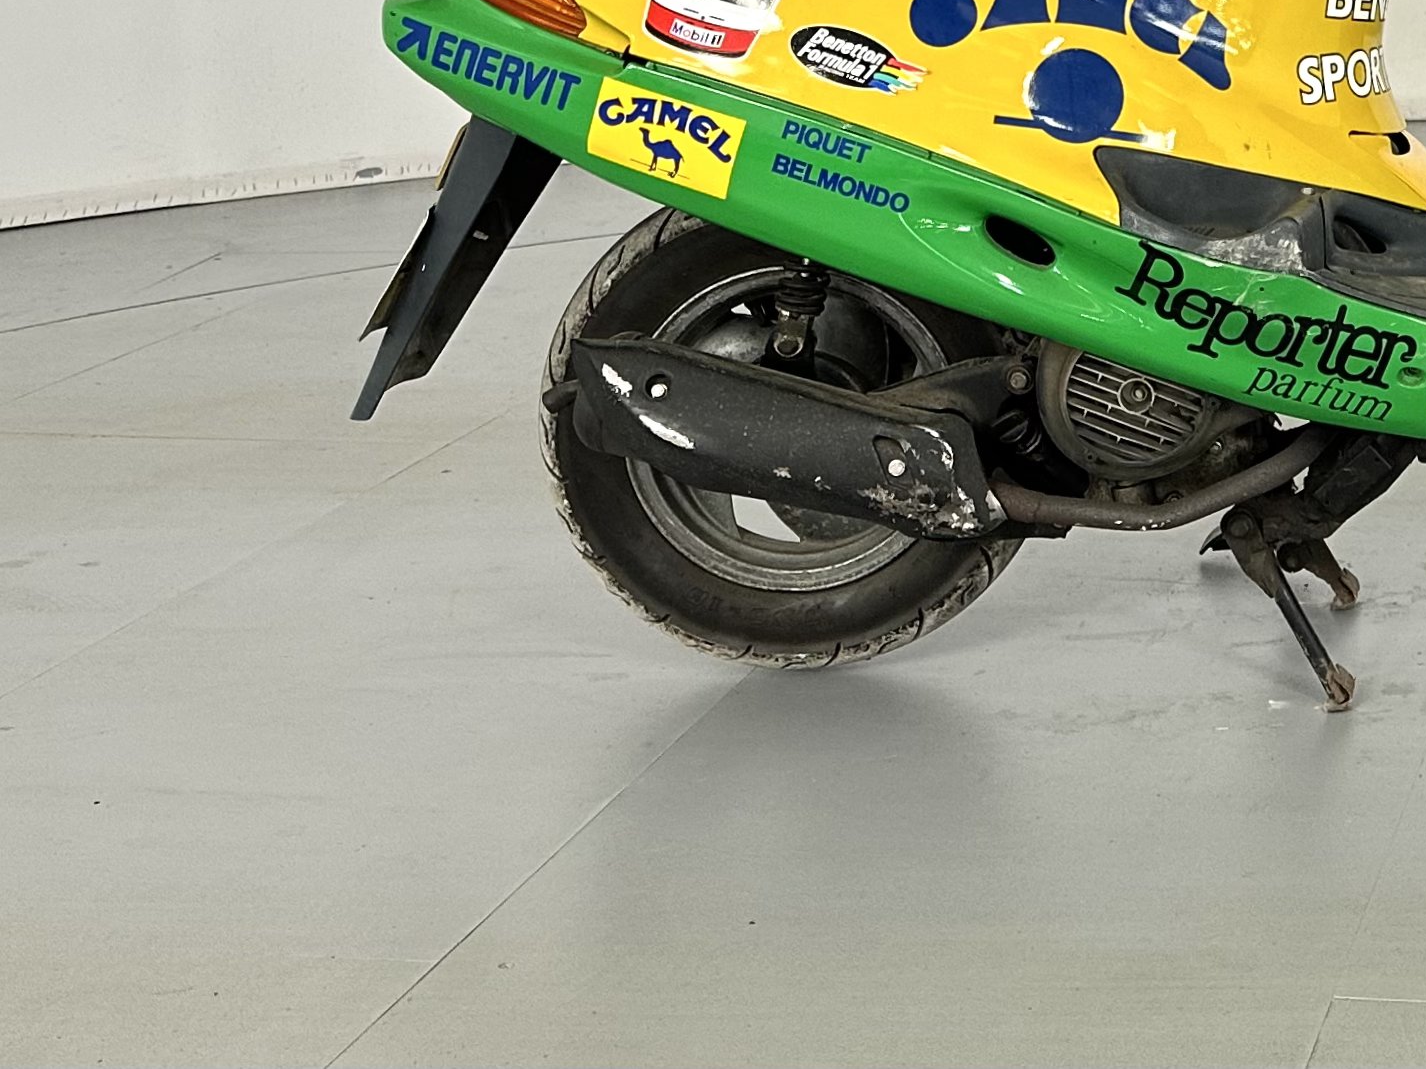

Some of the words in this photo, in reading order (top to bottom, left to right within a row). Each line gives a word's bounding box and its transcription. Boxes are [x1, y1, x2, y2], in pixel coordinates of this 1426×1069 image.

[672, 21, 710, 44] Mobil
[796, 40, 867, 78] Formula
[809, 27, 887, 66] Benetton
[430, 33, 582, 111] ENERVIT
[597, 97, 732, 163] CAMEL
[781, 119, 872, 164] PIQUET
[771, 153, 910, 213] BELMONDO
[1114, 239, 1418, 389] Reporter
[1242, 366, 1393, 422] parfum
